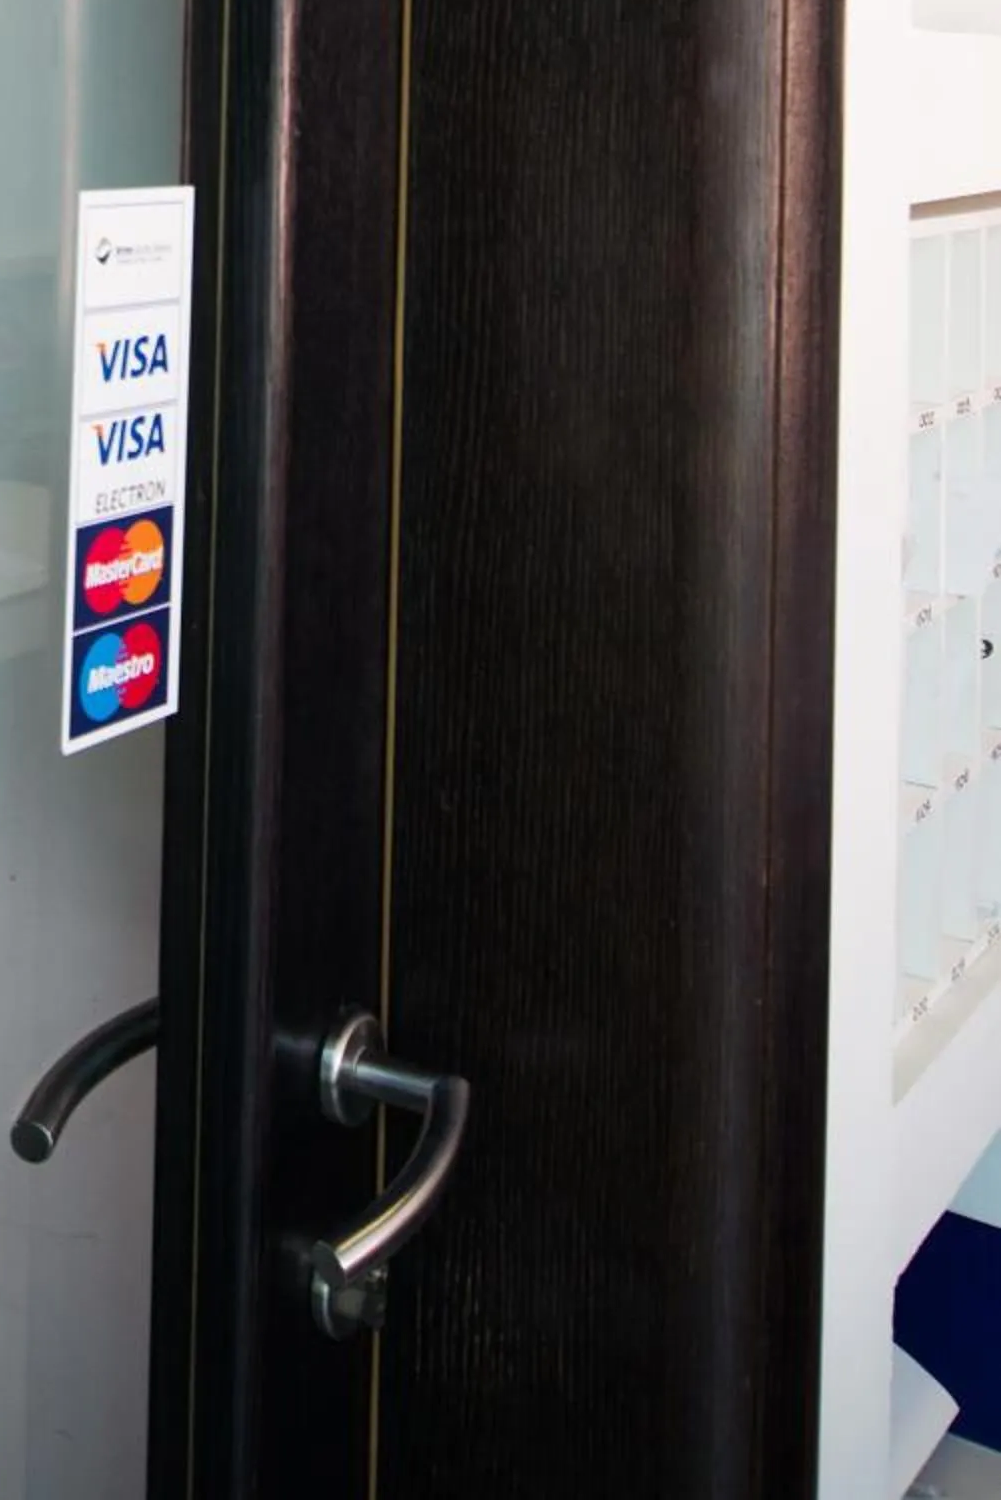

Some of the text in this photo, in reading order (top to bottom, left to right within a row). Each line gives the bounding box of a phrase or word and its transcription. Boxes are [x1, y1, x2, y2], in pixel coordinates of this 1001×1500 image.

[95, 333, 169, 382] VISA
[91, 412, 165, 466] VISA
[95, 478, 166, 513] ELECTRON
[84, 546, 164, 589] MasterCard
[86, 652, 155, 694] Maestro
